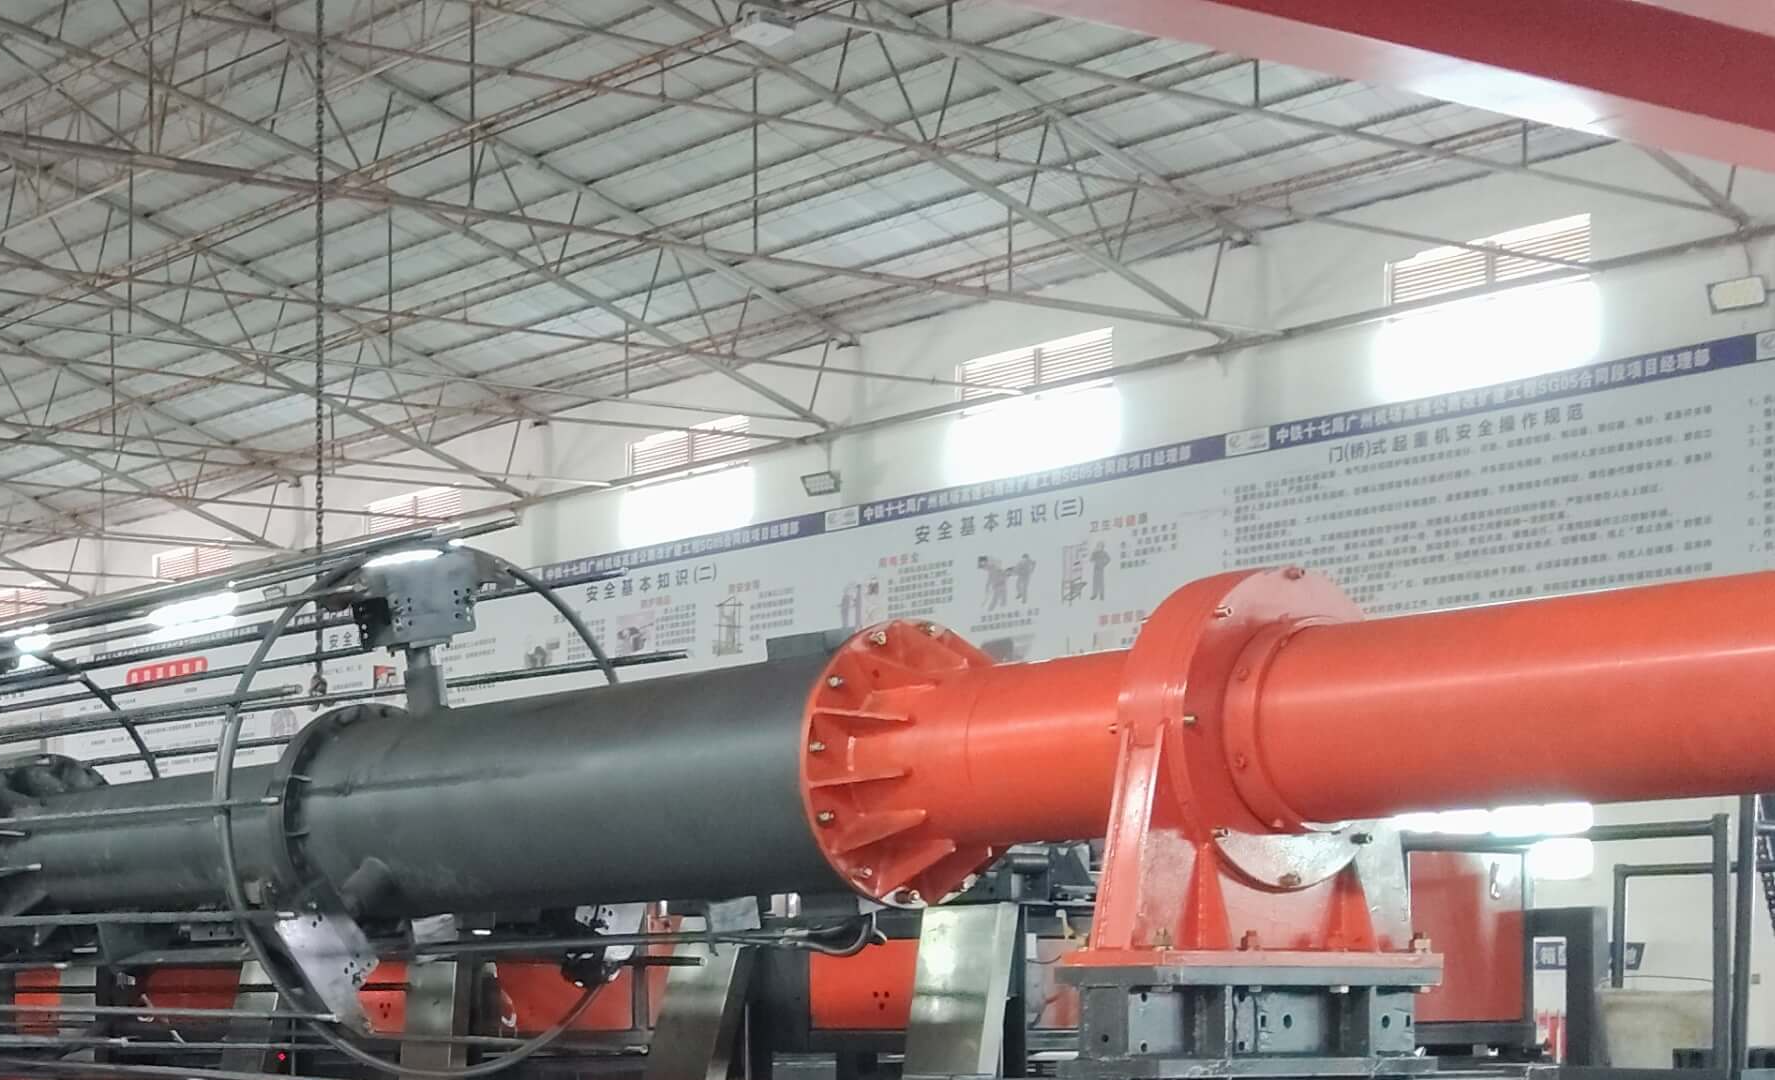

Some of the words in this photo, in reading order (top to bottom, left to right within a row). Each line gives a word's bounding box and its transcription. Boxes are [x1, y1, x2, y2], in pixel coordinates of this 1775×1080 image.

[914, 498, 1084, 545] 安全基本知识(三)
